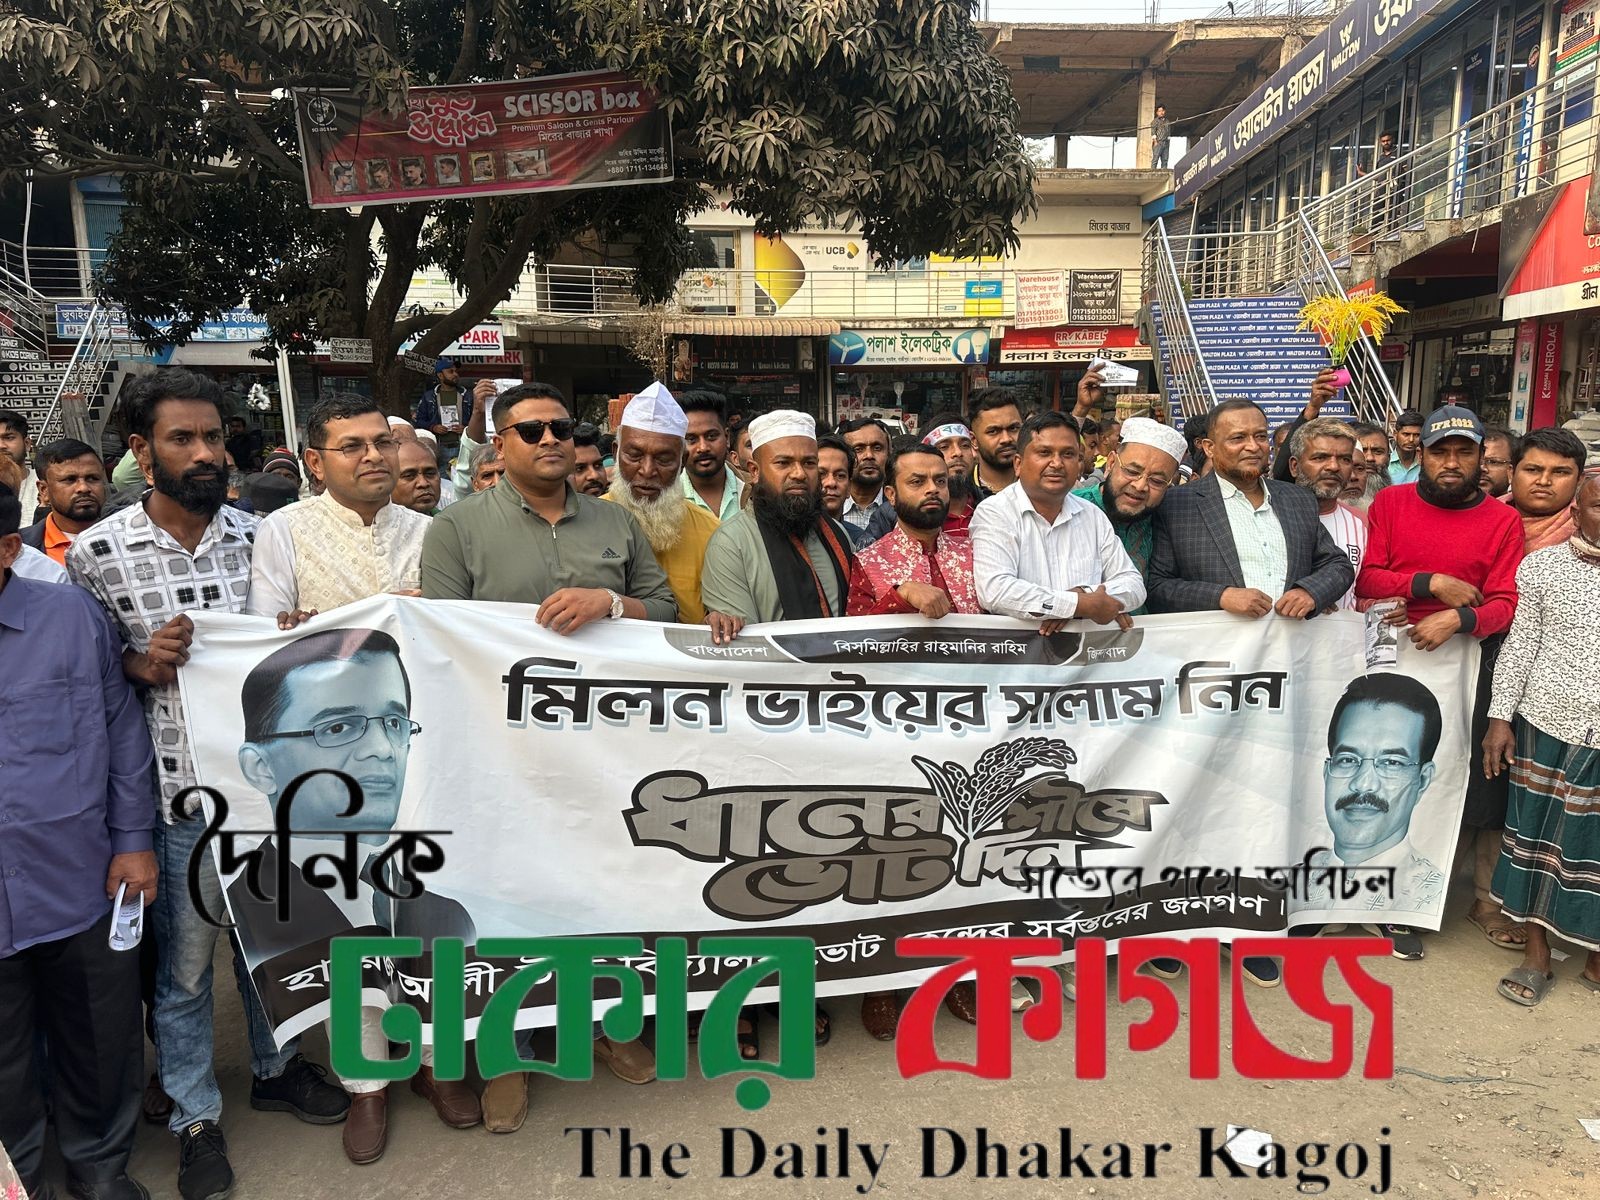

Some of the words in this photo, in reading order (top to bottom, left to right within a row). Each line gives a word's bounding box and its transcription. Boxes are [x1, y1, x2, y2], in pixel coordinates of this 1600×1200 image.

[1331, 37, 1361, 72] WALTON
[503, 89, 598, 118] SCISSOR
[601, 87, 641, 110] box
[1233, 86, 1285, 150] ওয়ালটন
[1286, 50, 1326, 111] প্লাজা
[408, 111, 497, 147] উদ্বোধন
[511, 124, 546, 133] Premium
[547, 121, 574, 130] Saloon
[583, 119, 605, 128] Gents
[607, 116, 634, 125] Parlour
[538, 131, 564, 142] মিরের
[566, 129, 591, 140] বাজার
[594, 127, 614, 137] শাখা
[1088, 220, 1109, 231] মিরের
[1110, 220, 1130, 231] বাজার
[826, 247, 845, 255] UCB
[1581, 282, 1599, 300] গ্রীন
[463, 331, 499, 343] PARK
[866, 335, 897, 353] পলাশ
[900, 330, 952, 354] ইলেকট্রিক
[1055, 331, 1068, 341] RR
[1005, 351, 1049, 361] পলাশ
[1052, 348, 1128, 362] ইলেকট্রিক
[1544, 324, 1557, 371] NEROLAC
[487, 352, 521, 363] PARK
[18, 362, 50, 371] KIDS
[12, 374, 44, 382] KIDS
[5, 386, 38, 395] KIDS
[0, 399, 33, 408] KIDS
[687, 643, 768, 658] বাংলাদেশ
[990, 640, 1027, 656] রাহিম
[503, 658, 729, 729] মিলন
[744, 673, 989, 735] ভাইয়ের
[998, 676, 1166, 729] সালাম
[1175, 660, 1287, 716] নিন
[622, 769, 946, 863] ধানের
[702, 836, 956, 922] ভোট
[1159, 892, 1274, 917] জনগণ
